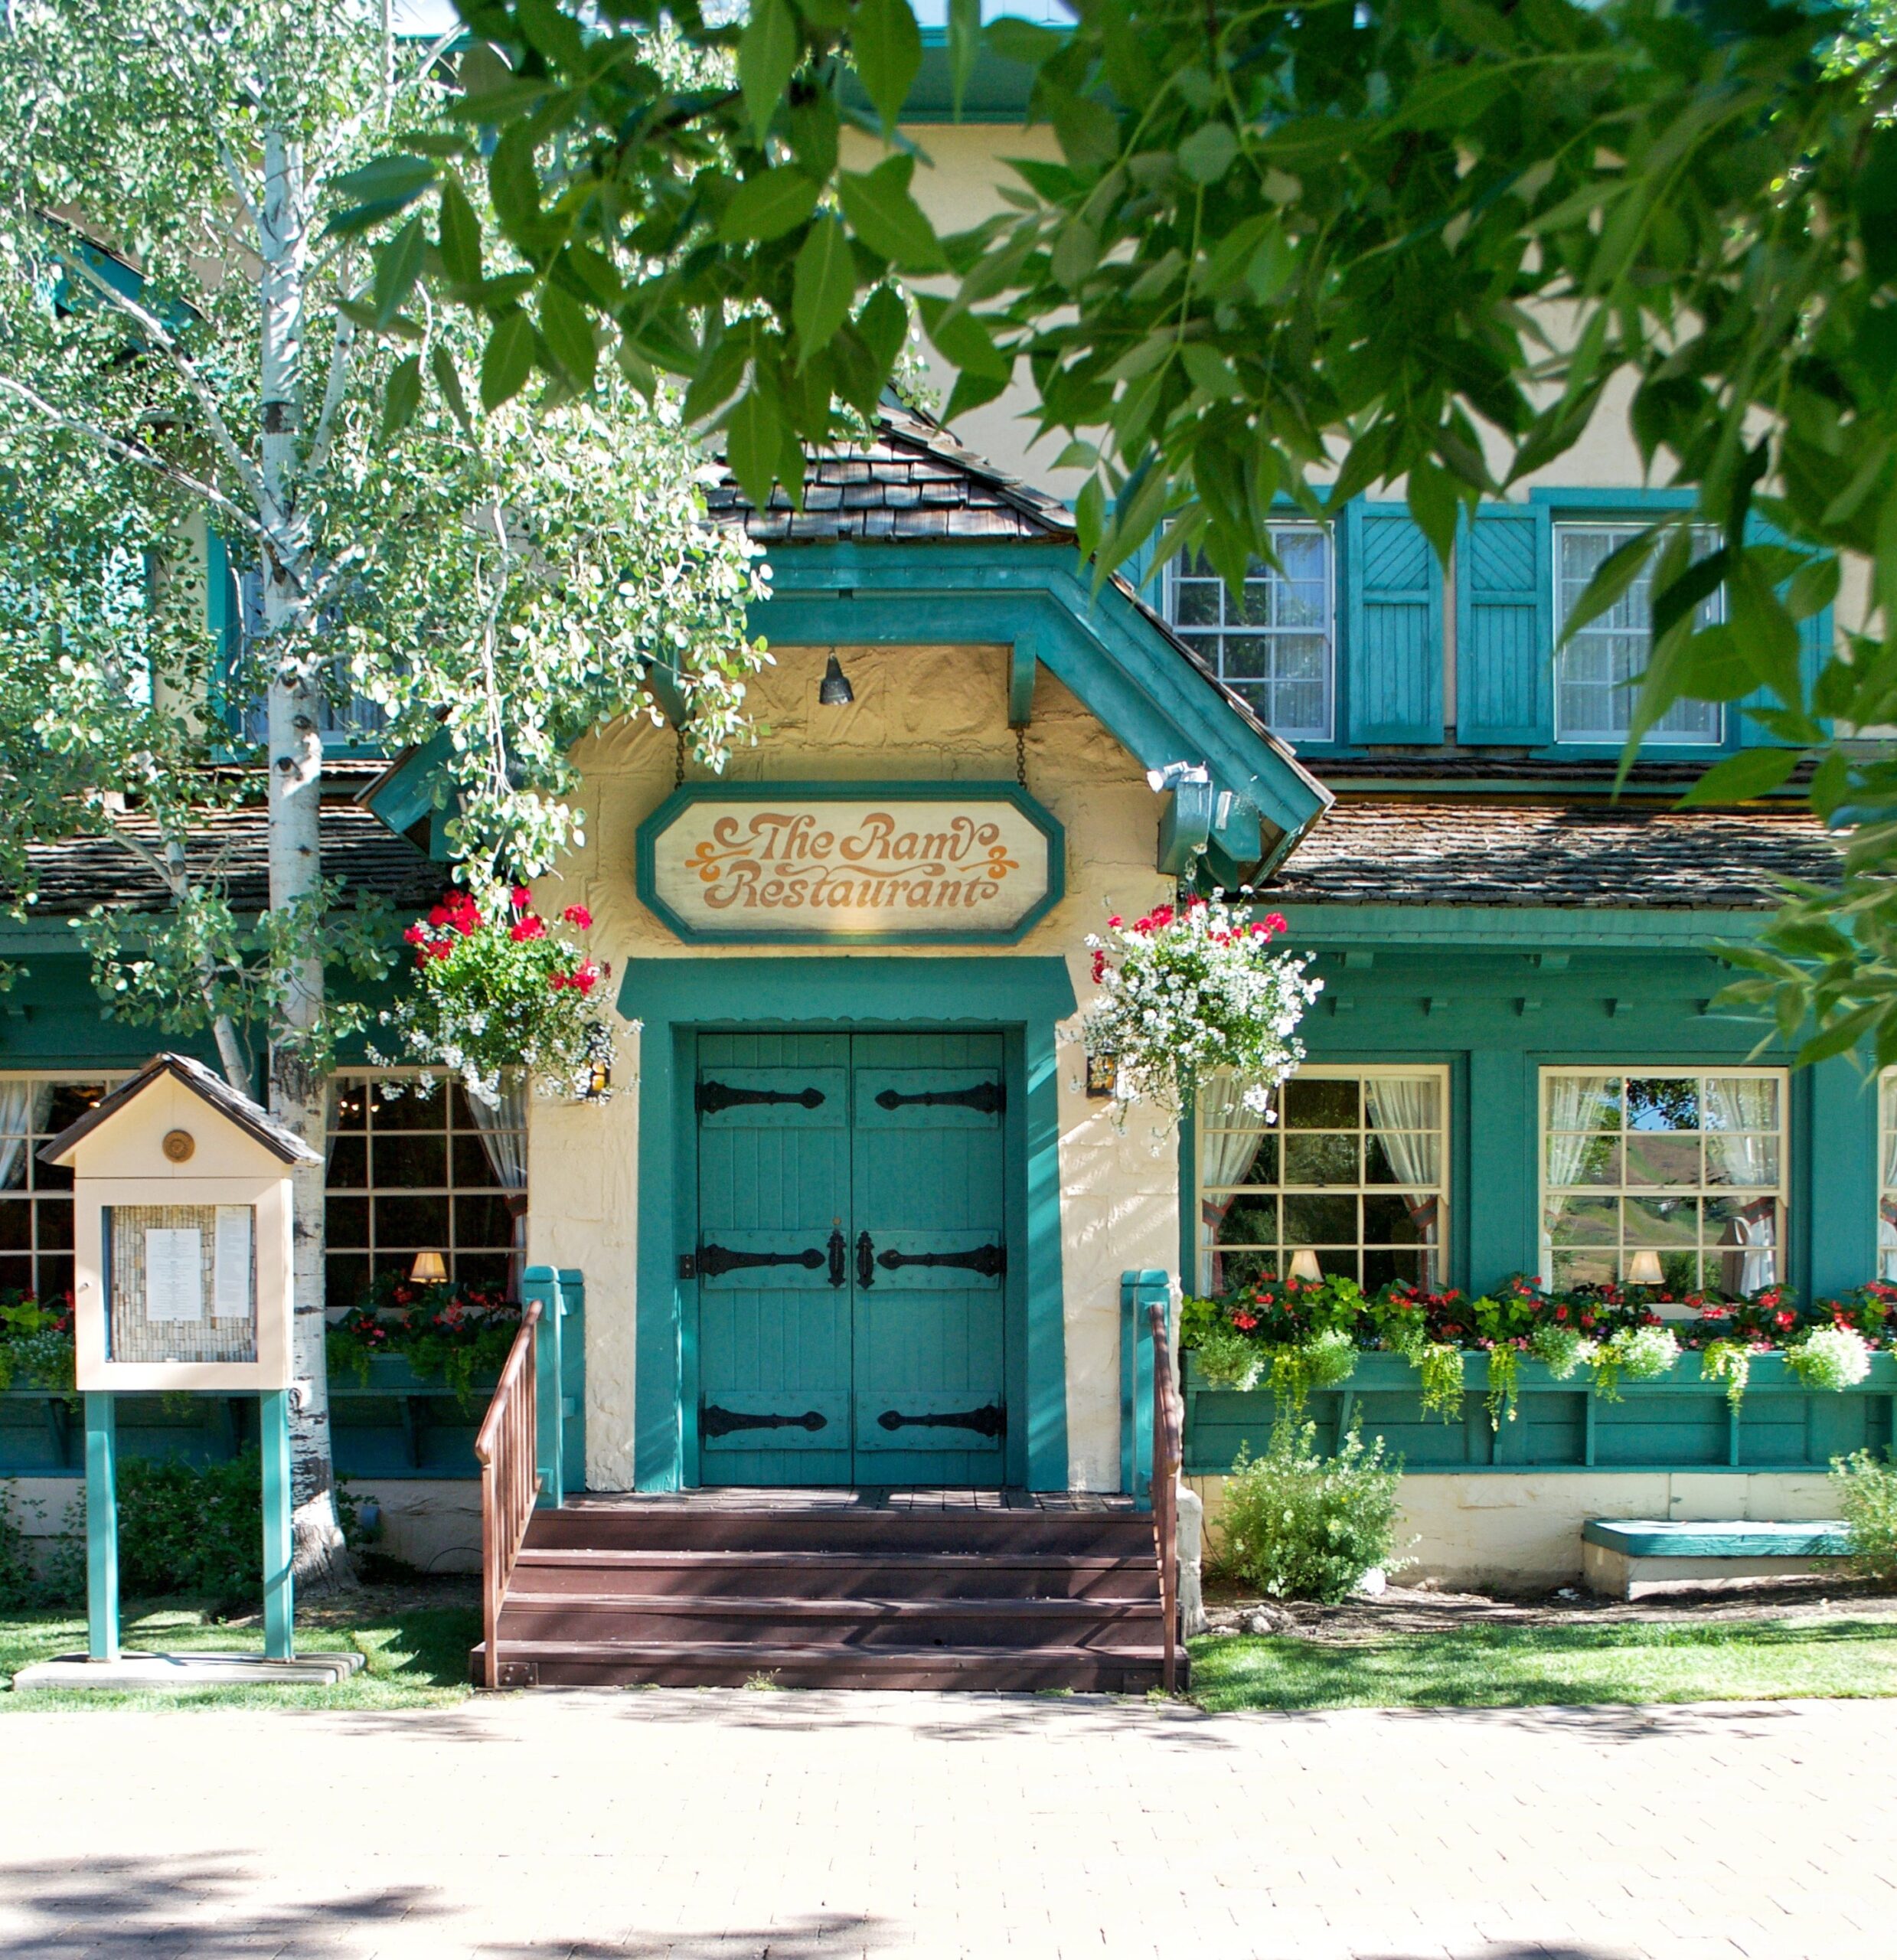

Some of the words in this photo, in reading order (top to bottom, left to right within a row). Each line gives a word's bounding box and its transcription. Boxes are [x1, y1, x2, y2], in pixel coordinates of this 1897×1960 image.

[713, 812, 834, 860] The
[839, 812, 1000, 861] Ram
[704, 860, 999, 909] Restaurant
